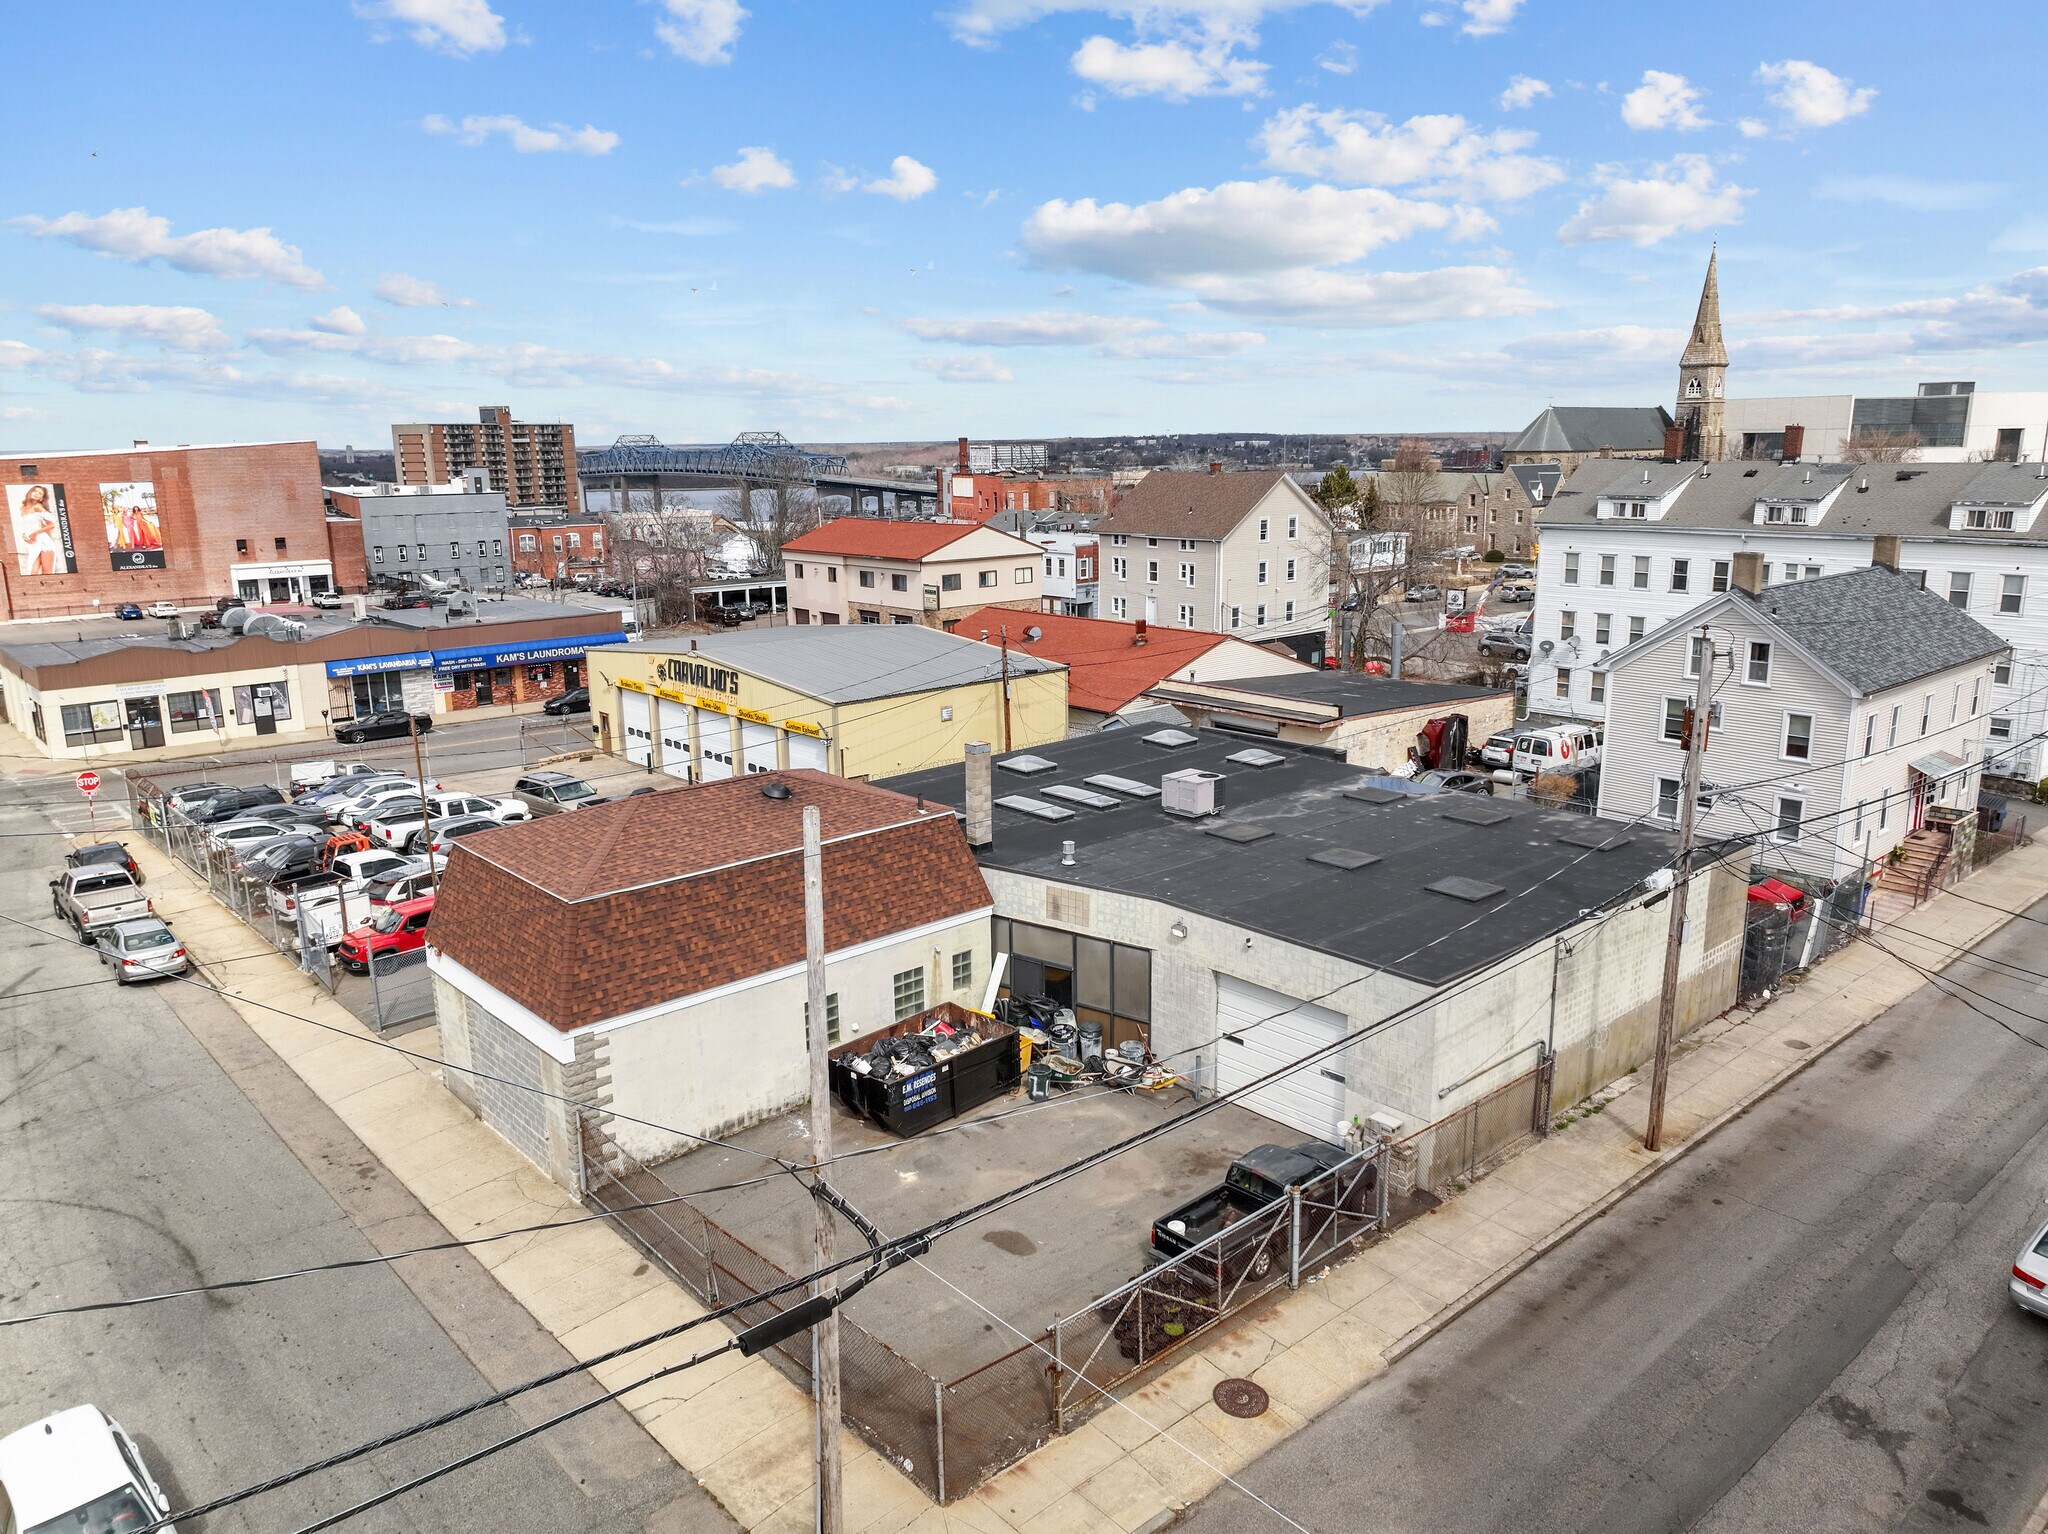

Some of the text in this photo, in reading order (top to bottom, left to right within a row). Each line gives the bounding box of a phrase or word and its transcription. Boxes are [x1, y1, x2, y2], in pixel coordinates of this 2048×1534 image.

[60, 508, 72, 549] ALEXANDRA'S
[496, 652, 526, 663] KAM'S
[357, 663, 378, 672] KAM'S
[667, 658, 739, 695] CARVALHO'S
[785, 721, 801, 731] Custom
[78, 777, 99, 787] STOP
